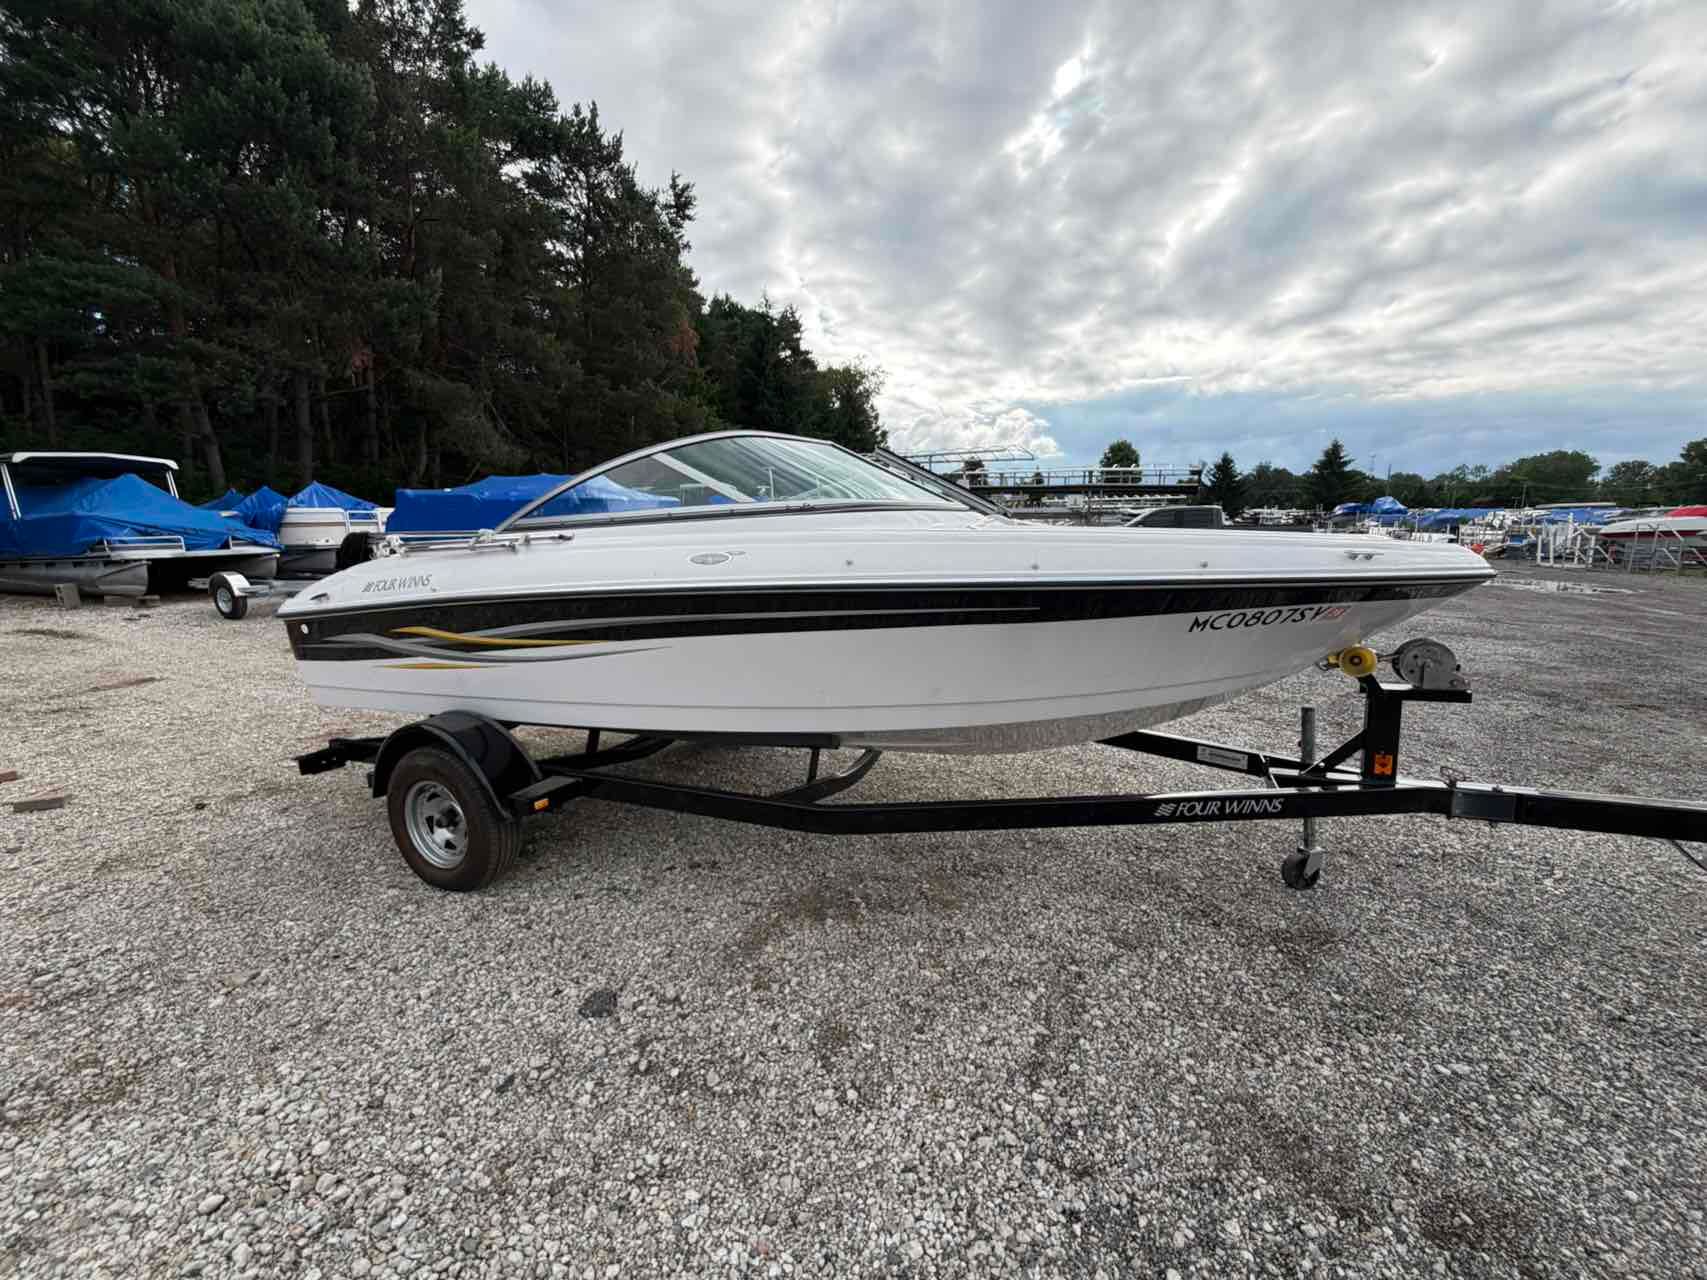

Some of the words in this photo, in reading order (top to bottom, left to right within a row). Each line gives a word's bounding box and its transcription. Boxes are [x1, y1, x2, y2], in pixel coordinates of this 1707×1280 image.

[1188, 606, 1329, 632] MC0807SV
[1175, 801, 1221, 816] FOUR
[1224, 798, 1285, 815] WINNS
